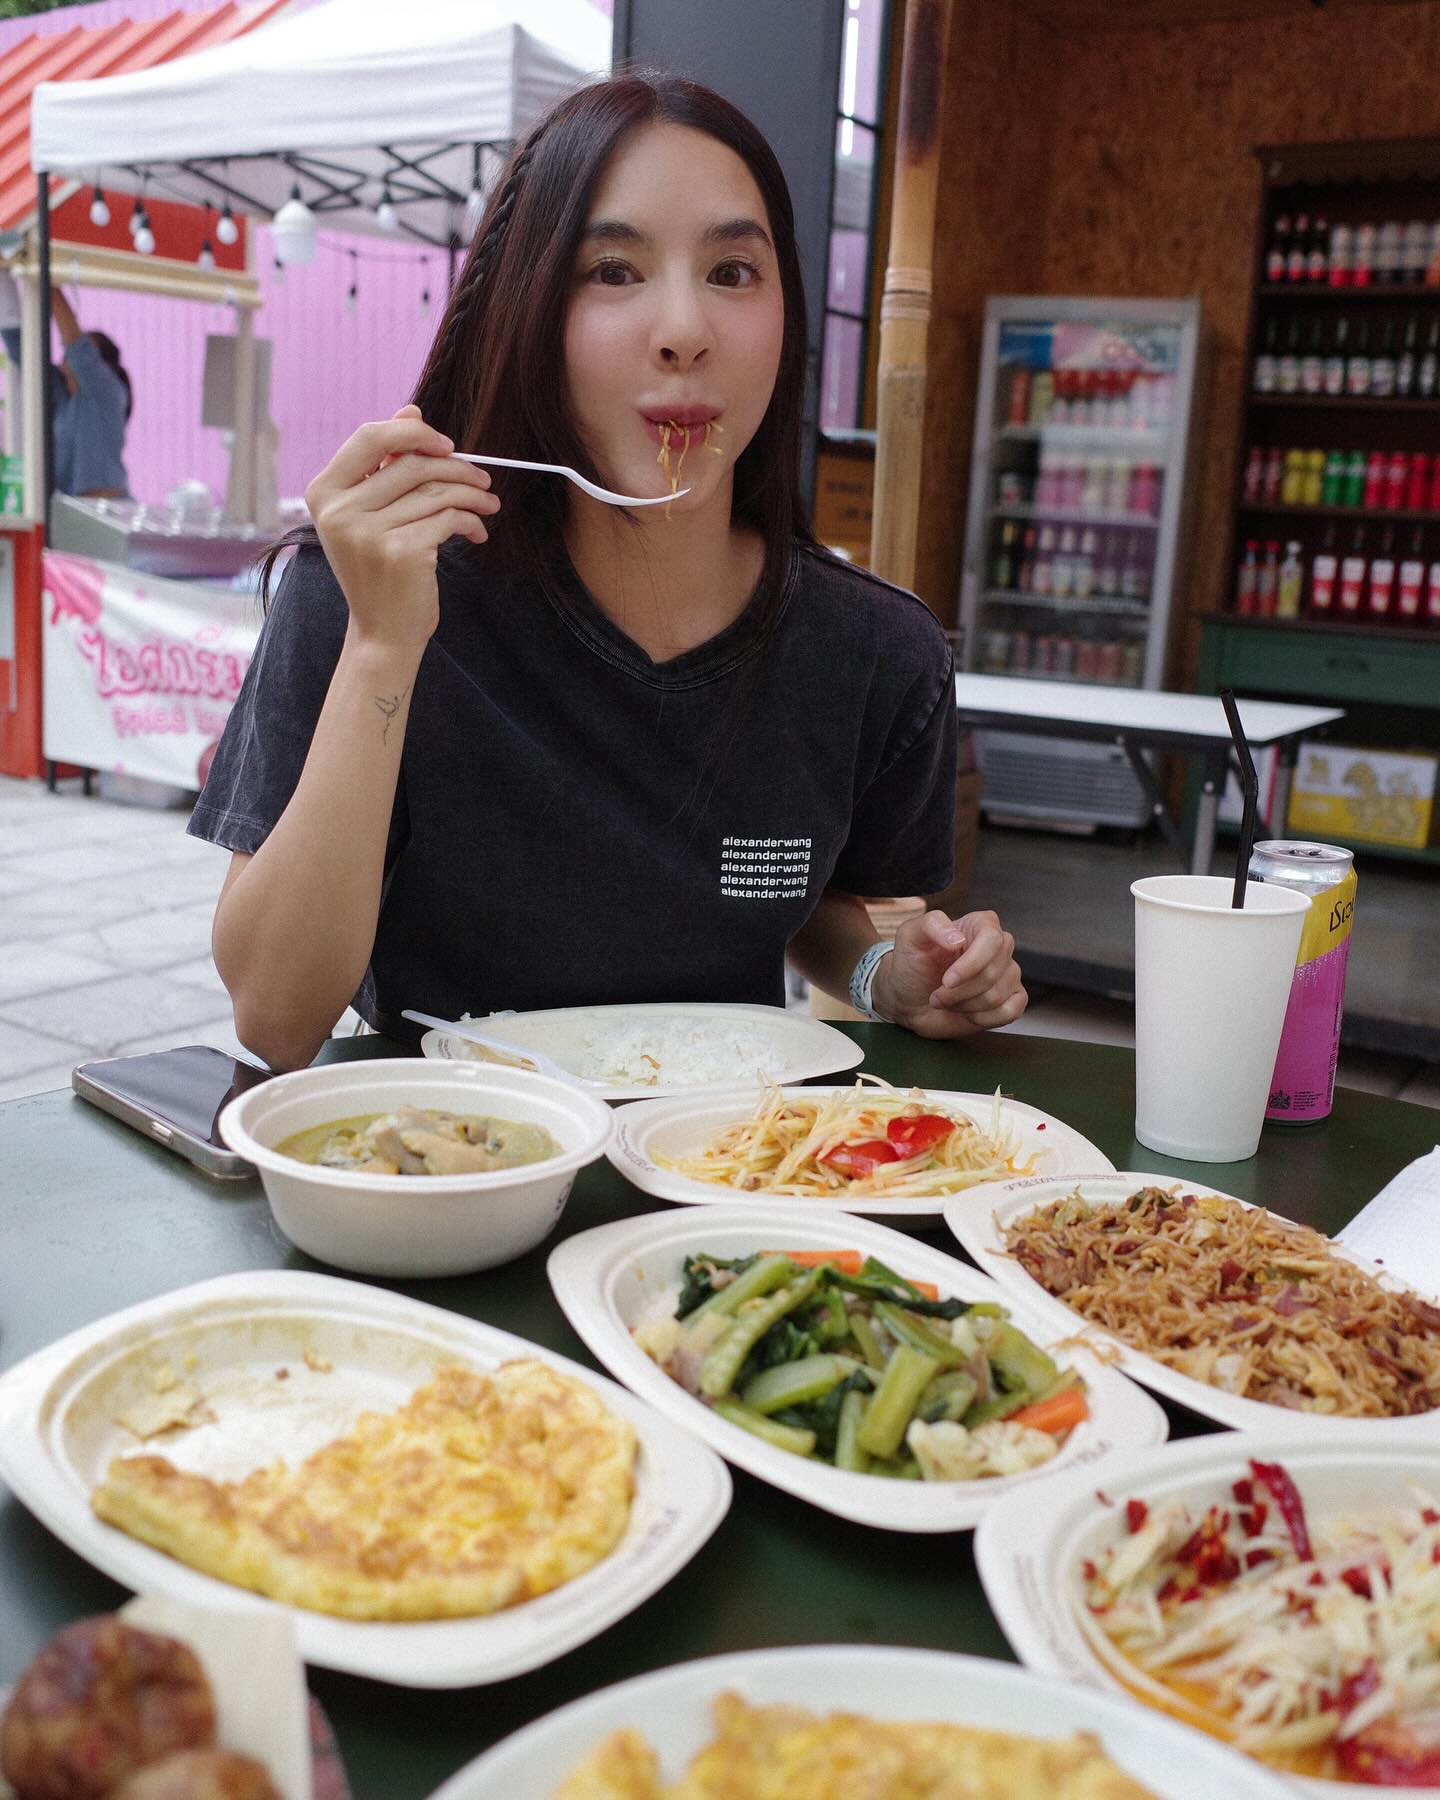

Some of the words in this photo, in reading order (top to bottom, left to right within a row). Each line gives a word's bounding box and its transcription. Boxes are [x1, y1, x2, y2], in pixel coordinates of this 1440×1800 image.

[722, 836, 812, 848] alexanderwang
[721, 849, 811, 860] alexanderwang
[720, 862, 810, 873] alexanderwang
[720, 874, 808, 886] alexanderwang
[721, 886, 807, 899] alexanderwang
